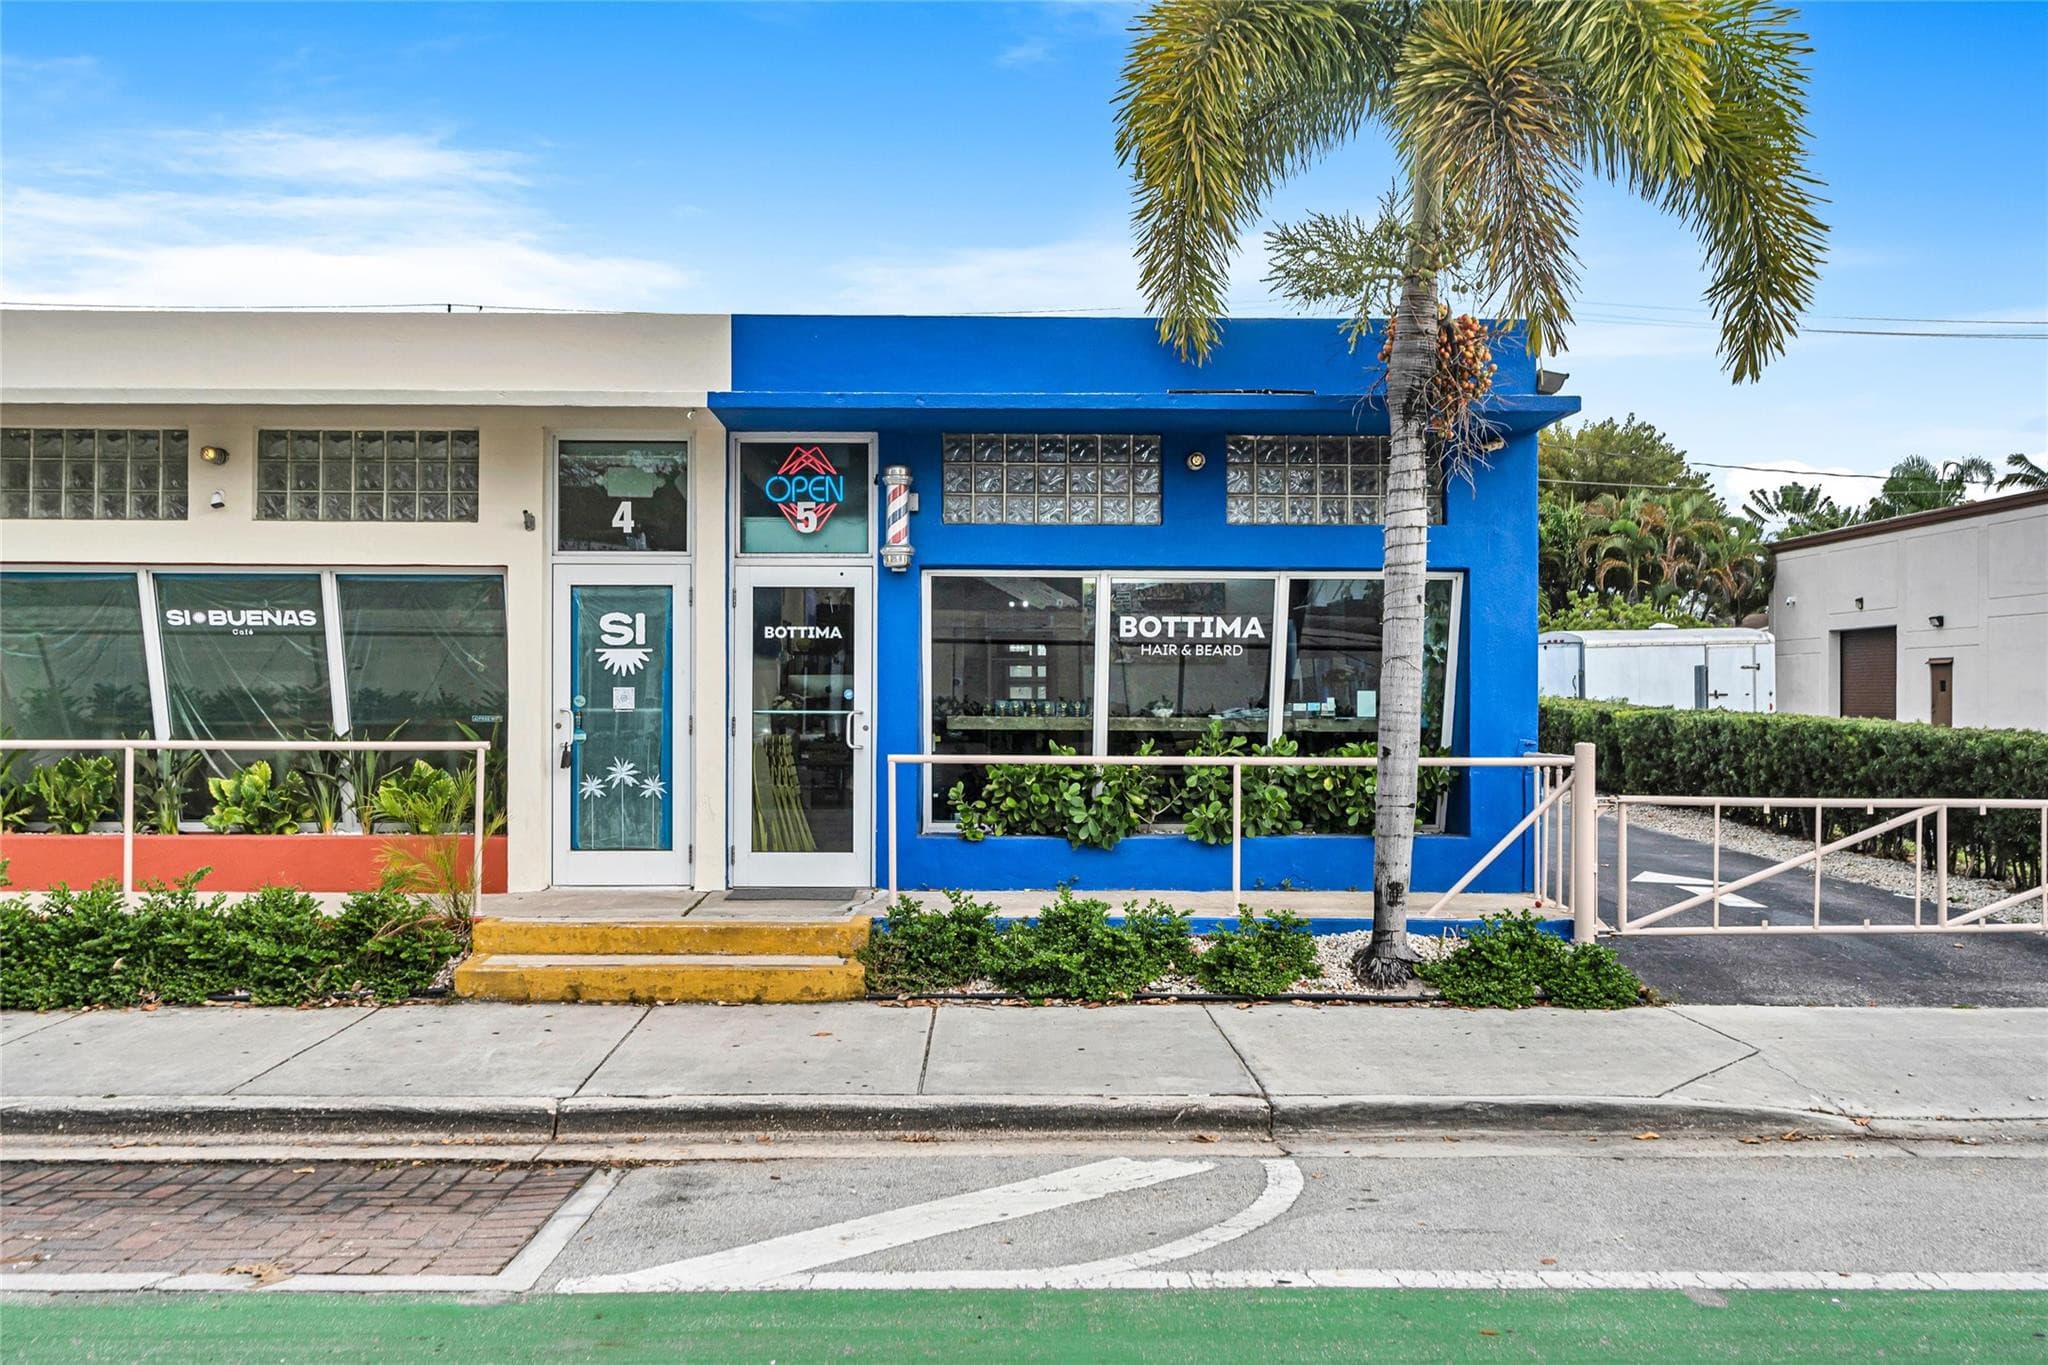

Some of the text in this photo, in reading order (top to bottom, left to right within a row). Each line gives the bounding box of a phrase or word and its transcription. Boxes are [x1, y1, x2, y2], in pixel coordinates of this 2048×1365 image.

[765, 475, 844, 502] OPEN
[611, 501, 635, 533] 4
[796, 501, 818, 533] 5
[165, 609, 318, 626] SI BUENAS
[599, 612, 646, 646] SI
[1119, 615, 1265, 639] BOTTIMA
[764, 626, 843, 639] BOTTIMA
[1140, 644, 1244, 656] HAIR & BEARD
